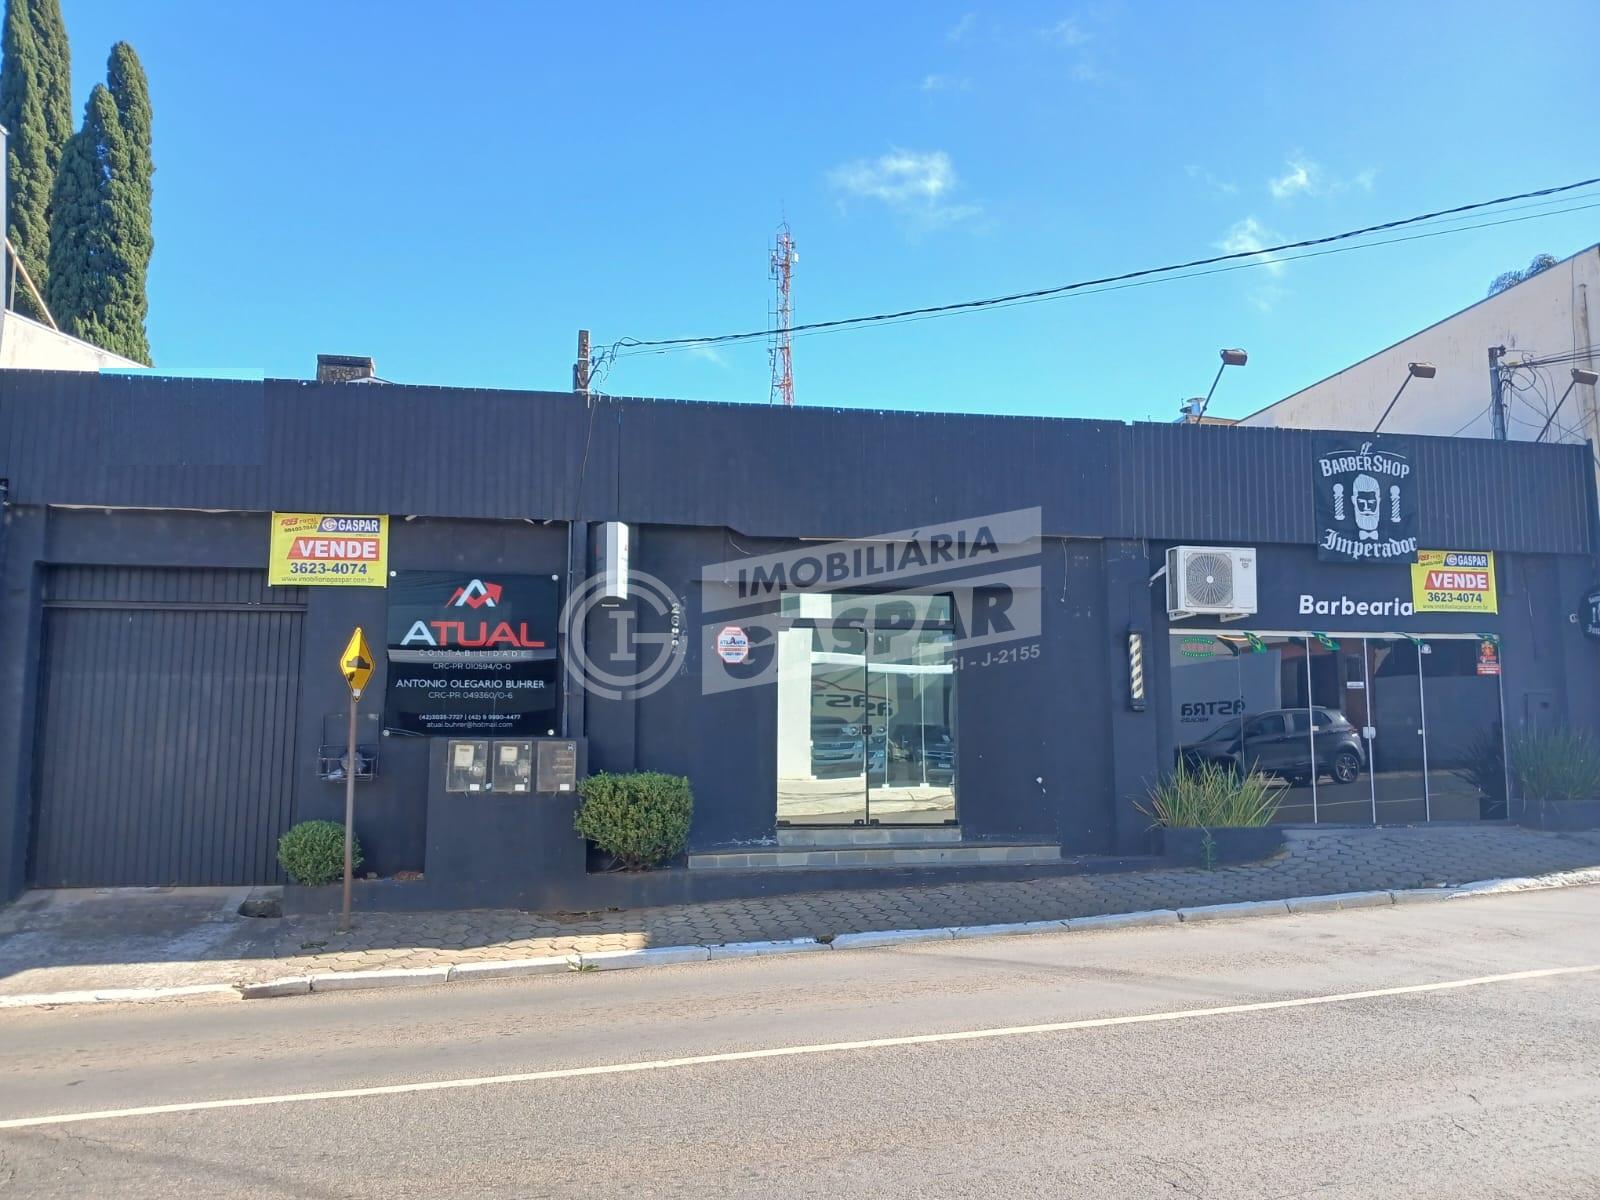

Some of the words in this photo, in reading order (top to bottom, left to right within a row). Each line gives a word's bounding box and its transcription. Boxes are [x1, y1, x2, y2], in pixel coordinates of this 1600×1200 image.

[338, 519, 379, 532] GASPAR
[299, 540, 377, 558] VENDE
[1319, 528, 1418, 559] Imperador
[1457, 555, 1488, 567] GASPAR
[290, 562, 368, 575] 3623-4074
[1431, 572, 1488, 589] VENDE
[1427, 592, 1482, 603] 3623-4074
[1299, 595, 1414, 616] Barbearia
[400, 620, 545, 647] ATUAL
[418, 650, 527, 658] CONTABILIDADE
[433, 662, 464, 671] CRC-PR
[396, 679, 447, 688] ANTONIO
[449, 680, 502, 689] OLEGARIO
[505, 680, 545, 689] BUHRER
[428, 691, 461, 700] CRC-PR
